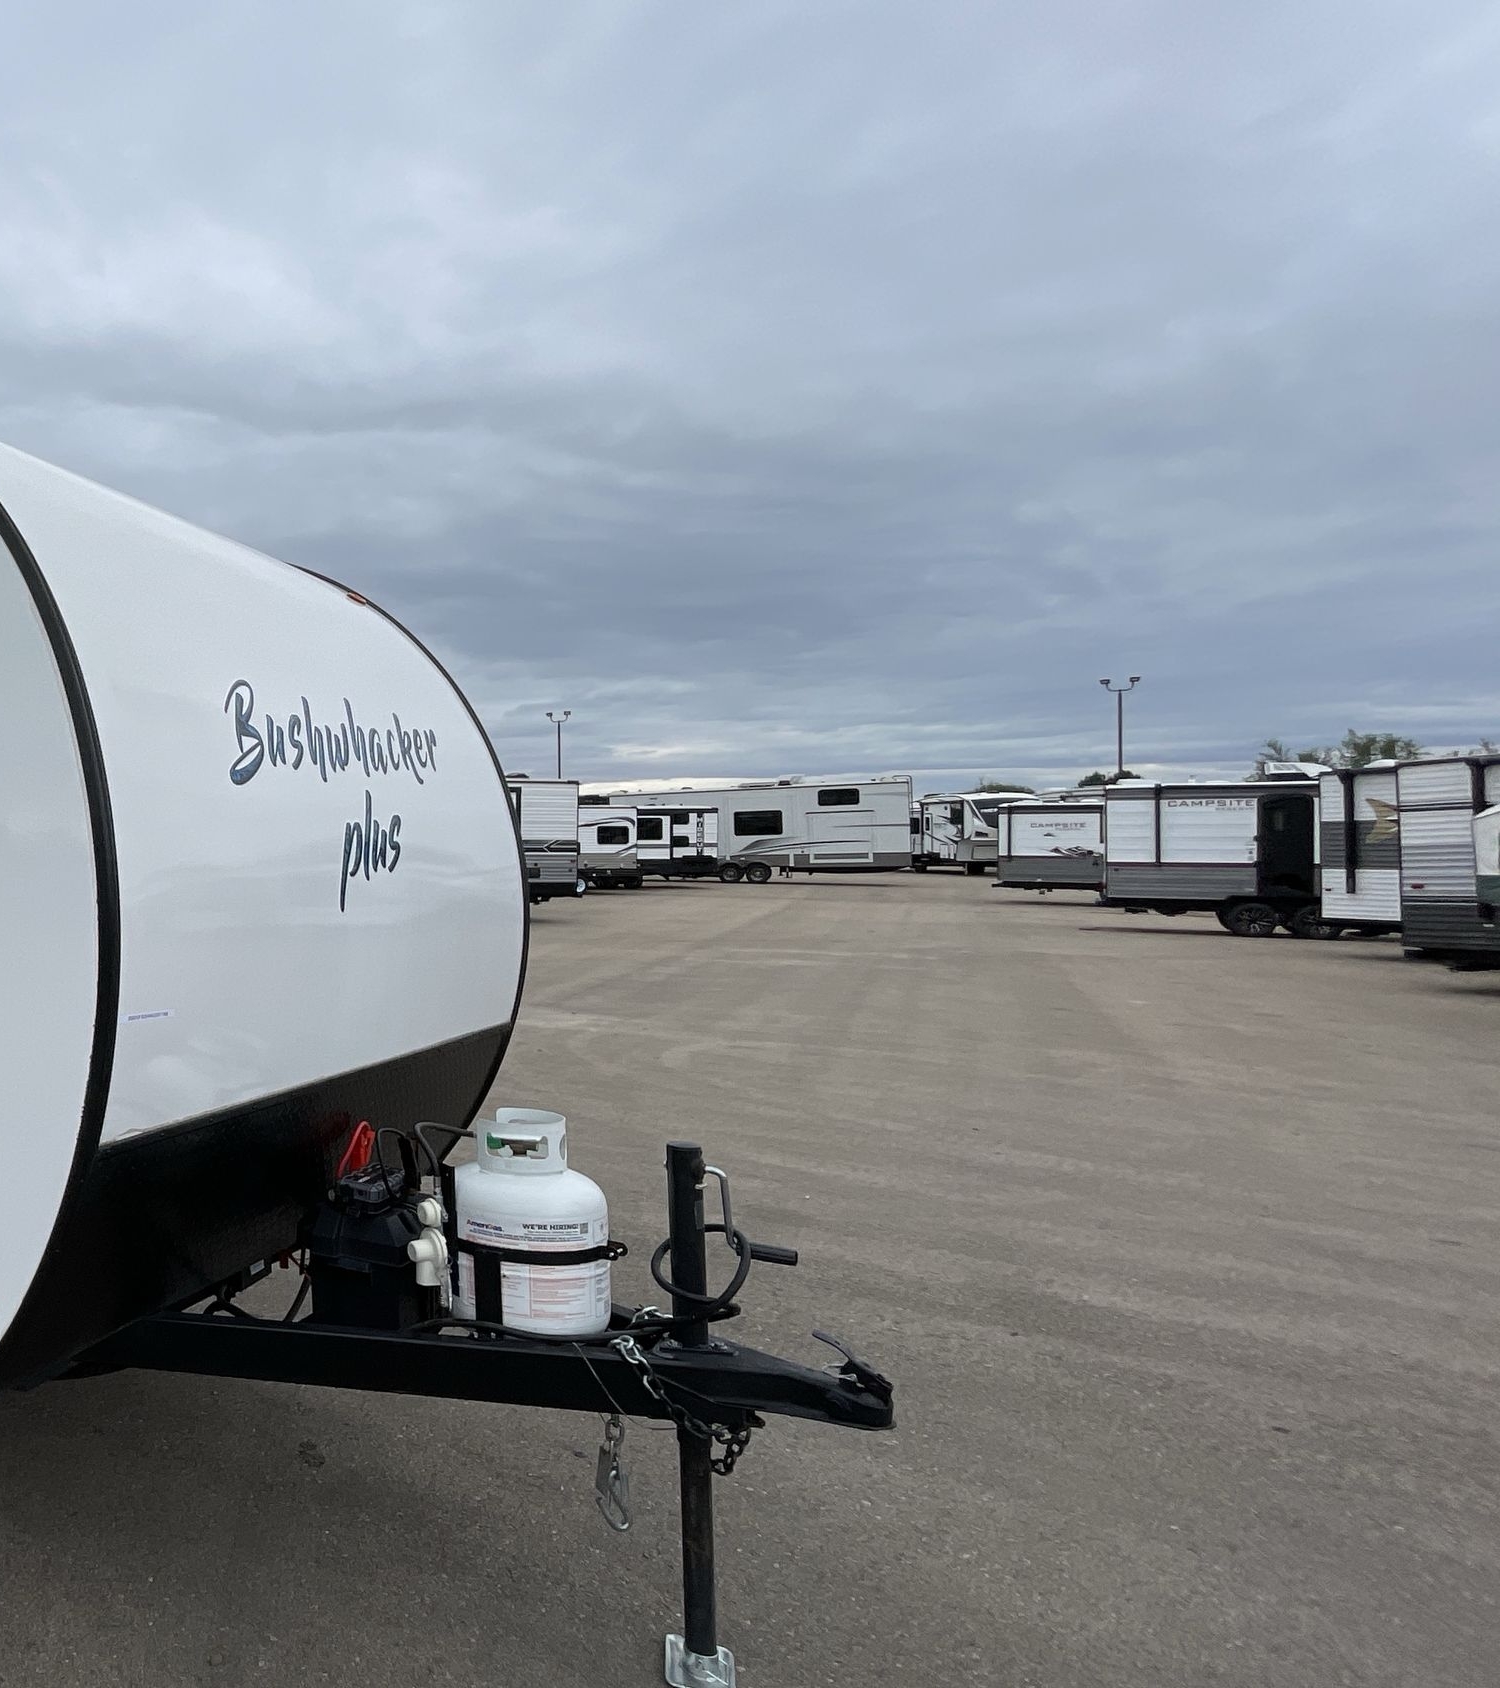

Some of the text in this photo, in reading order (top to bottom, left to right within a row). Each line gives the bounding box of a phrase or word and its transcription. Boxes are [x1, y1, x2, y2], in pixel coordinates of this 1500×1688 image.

[224, 679, 437, 785] Bushwhacker
[1166, 799, 1256, 808] CAMPSITE
[339, 790, 402, 913] plus
[522, 1223, 579, 1231] WE'RE HIRING!
